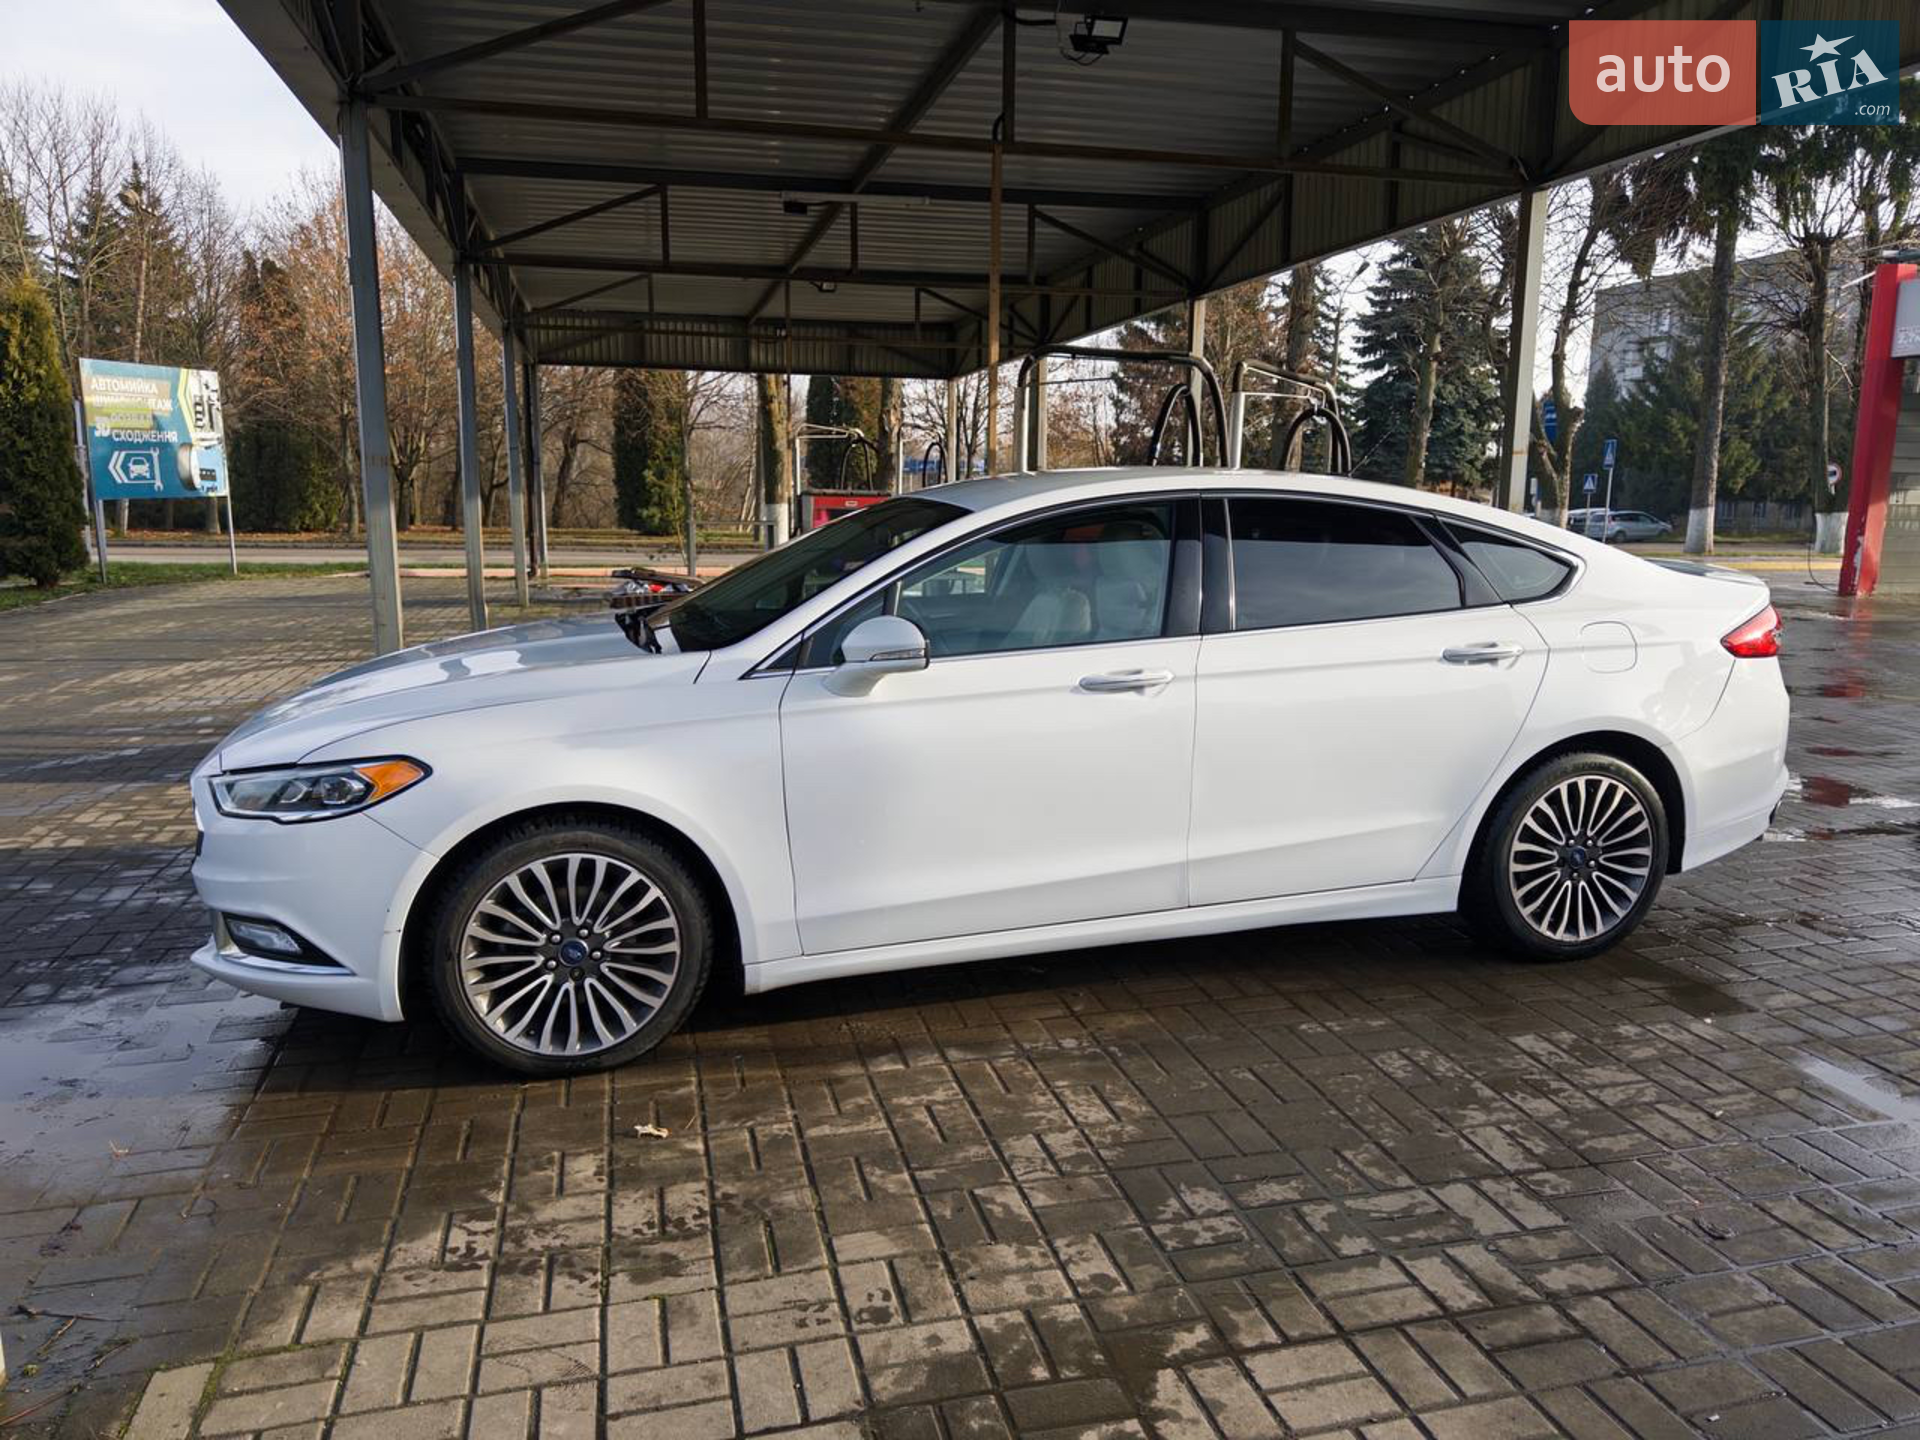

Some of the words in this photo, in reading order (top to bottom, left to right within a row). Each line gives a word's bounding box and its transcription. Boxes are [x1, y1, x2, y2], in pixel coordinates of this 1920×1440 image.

[91, 377, 158, 395] АВТОМИЙКА
[93, 395, 172, 412] ШИНОНТАЖ
[112, 429, 178, 443] СХОДЖЕННЯ
